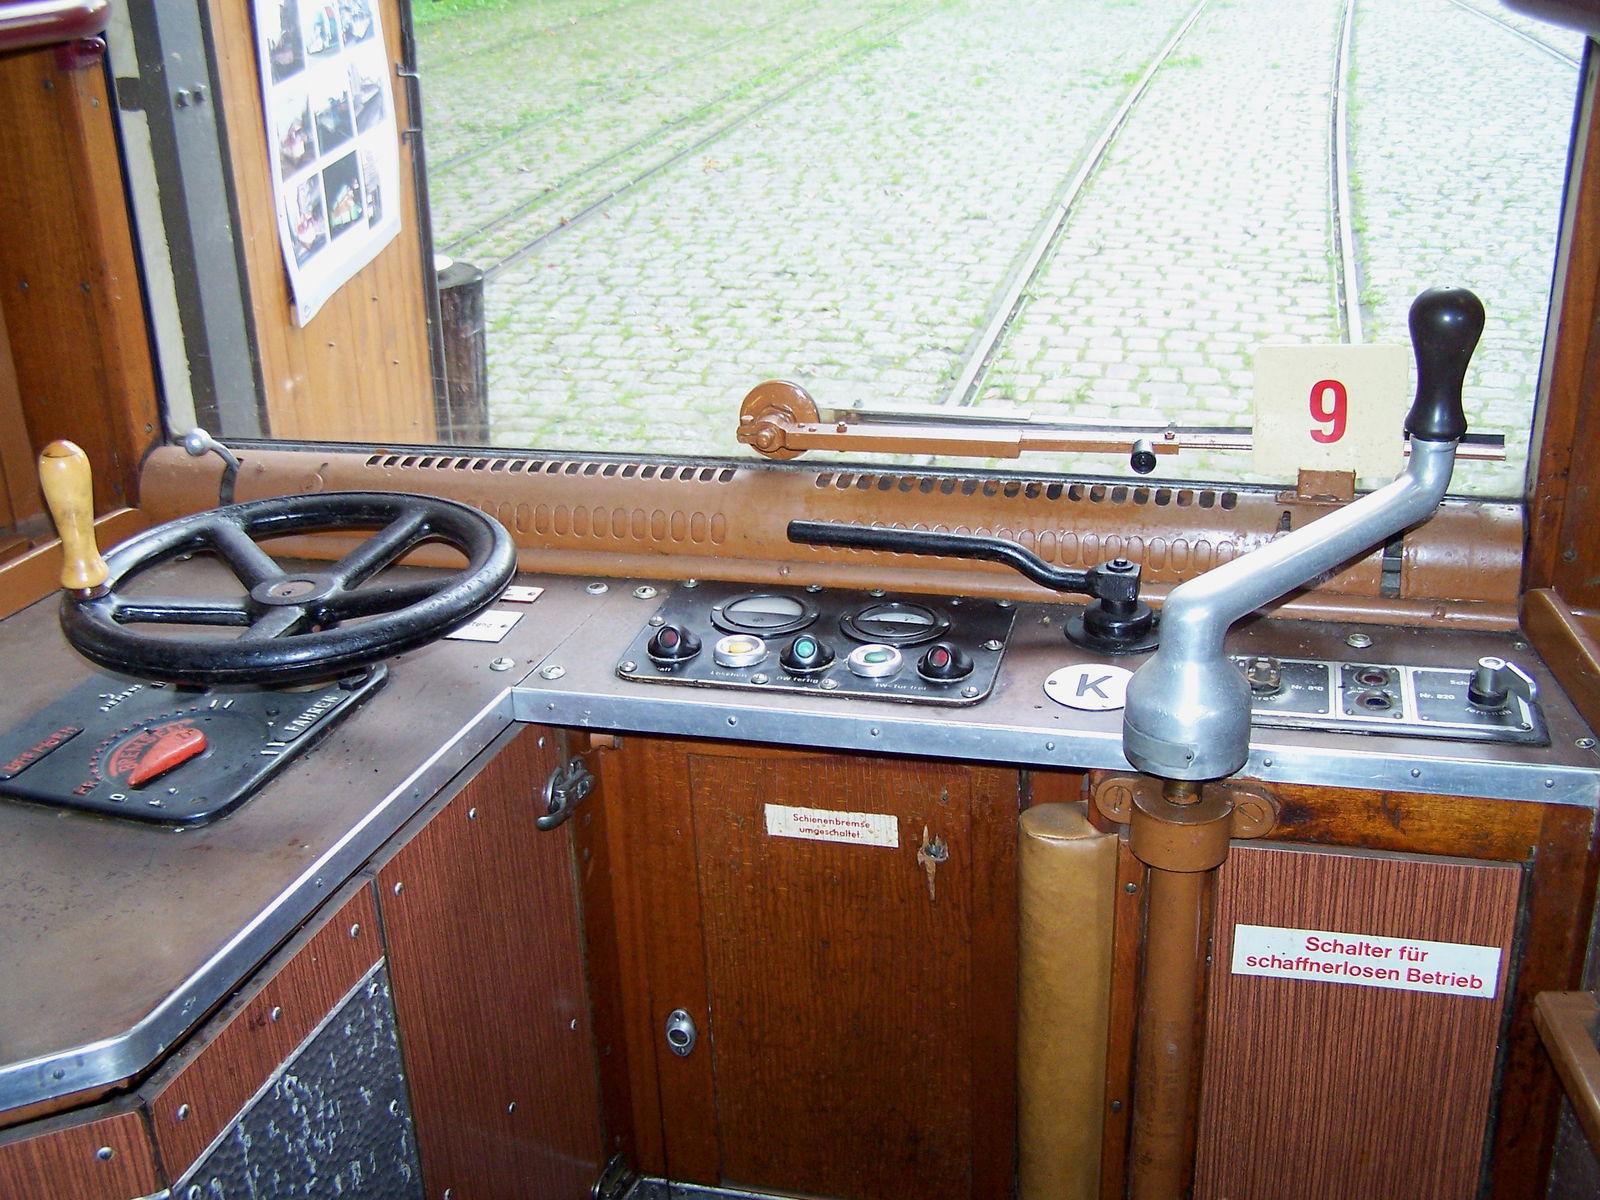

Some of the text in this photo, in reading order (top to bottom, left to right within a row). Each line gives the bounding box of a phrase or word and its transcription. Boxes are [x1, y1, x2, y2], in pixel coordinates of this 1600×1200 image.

[1309, 379, 1348, 444] 9
[1075, 673, 1113, 699] K
[284, 695, 339, 732] FAHREN
[793, 813, 871, 829] Schienenbremse
[1305, 936, 1428, 963] Schalter für
[1246, 955, 1483, 990] schaffnerlosen Betrieb
